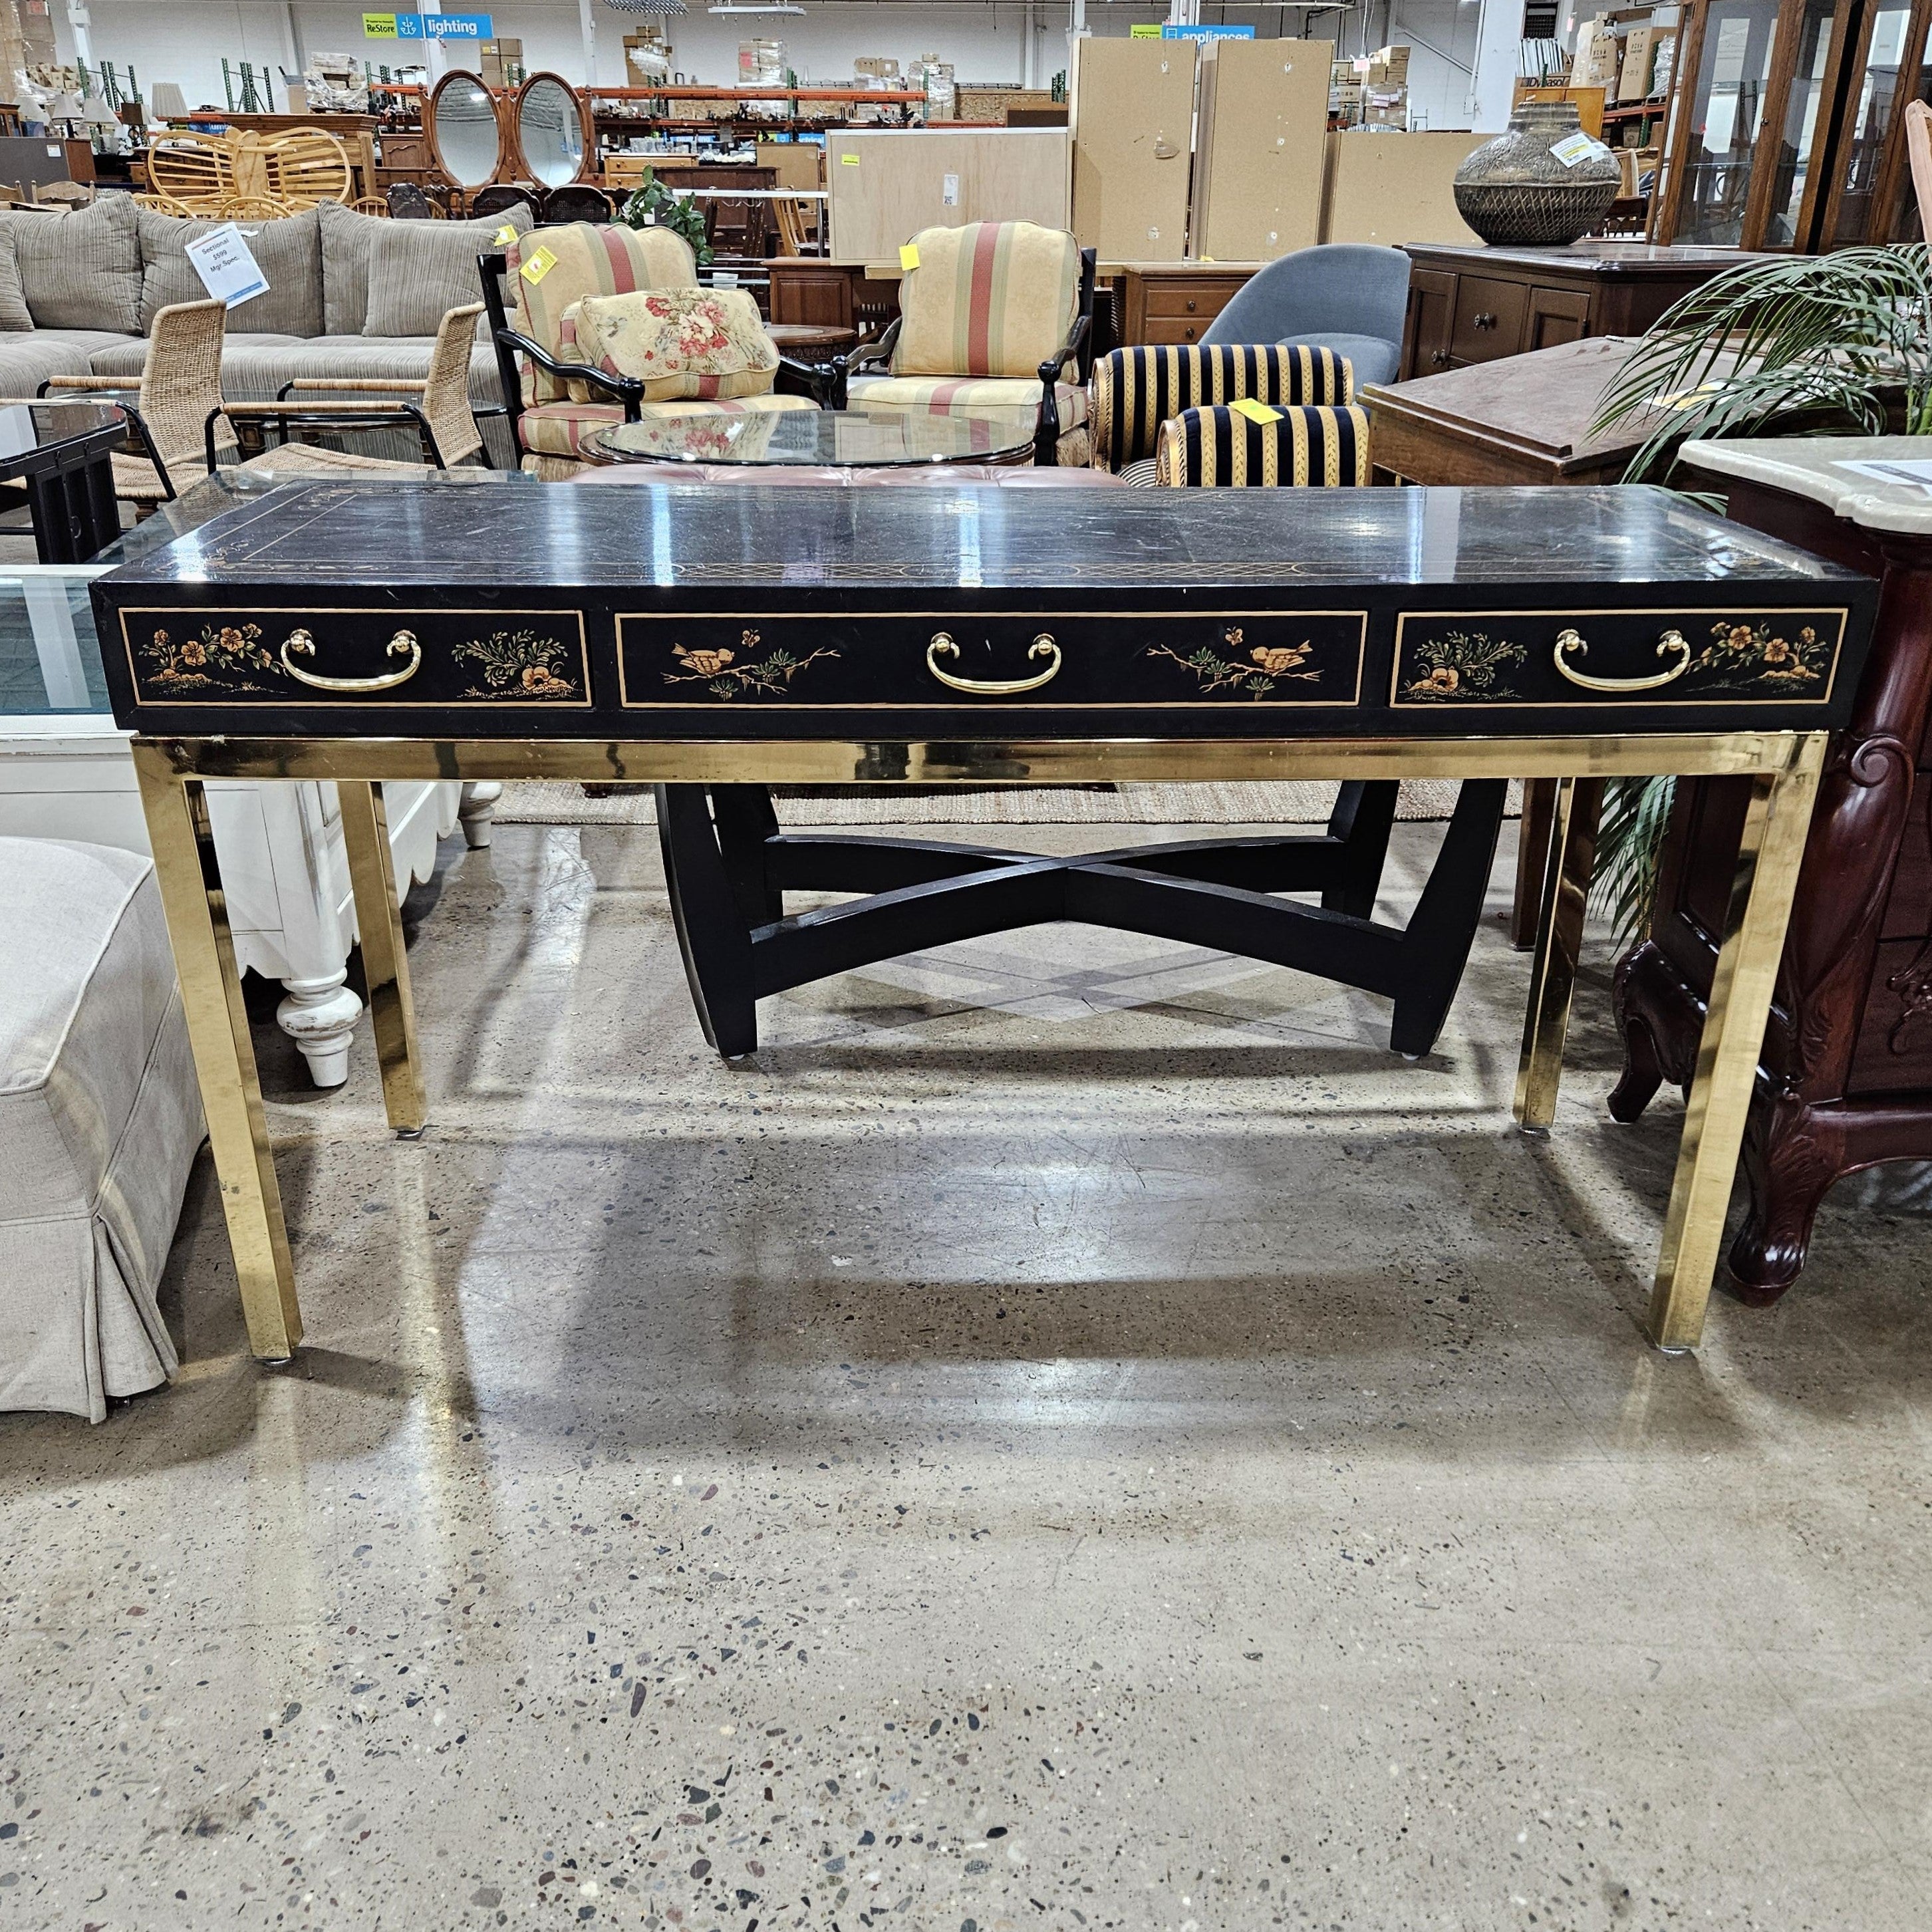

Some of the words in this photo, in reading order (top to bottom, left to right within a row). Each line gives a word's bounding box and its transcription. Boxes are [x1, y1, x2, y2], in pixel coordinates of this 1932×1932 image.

[366, 24, 395, 33] ReStore
[428, 19, 478, 35] lighting
[1182, 31, 1250, 46] appliances
[1529, 76, 1566, 87] Dyasol
[202, 238, 229, 255] Sectional
[213, 249, 227, 260] $599
